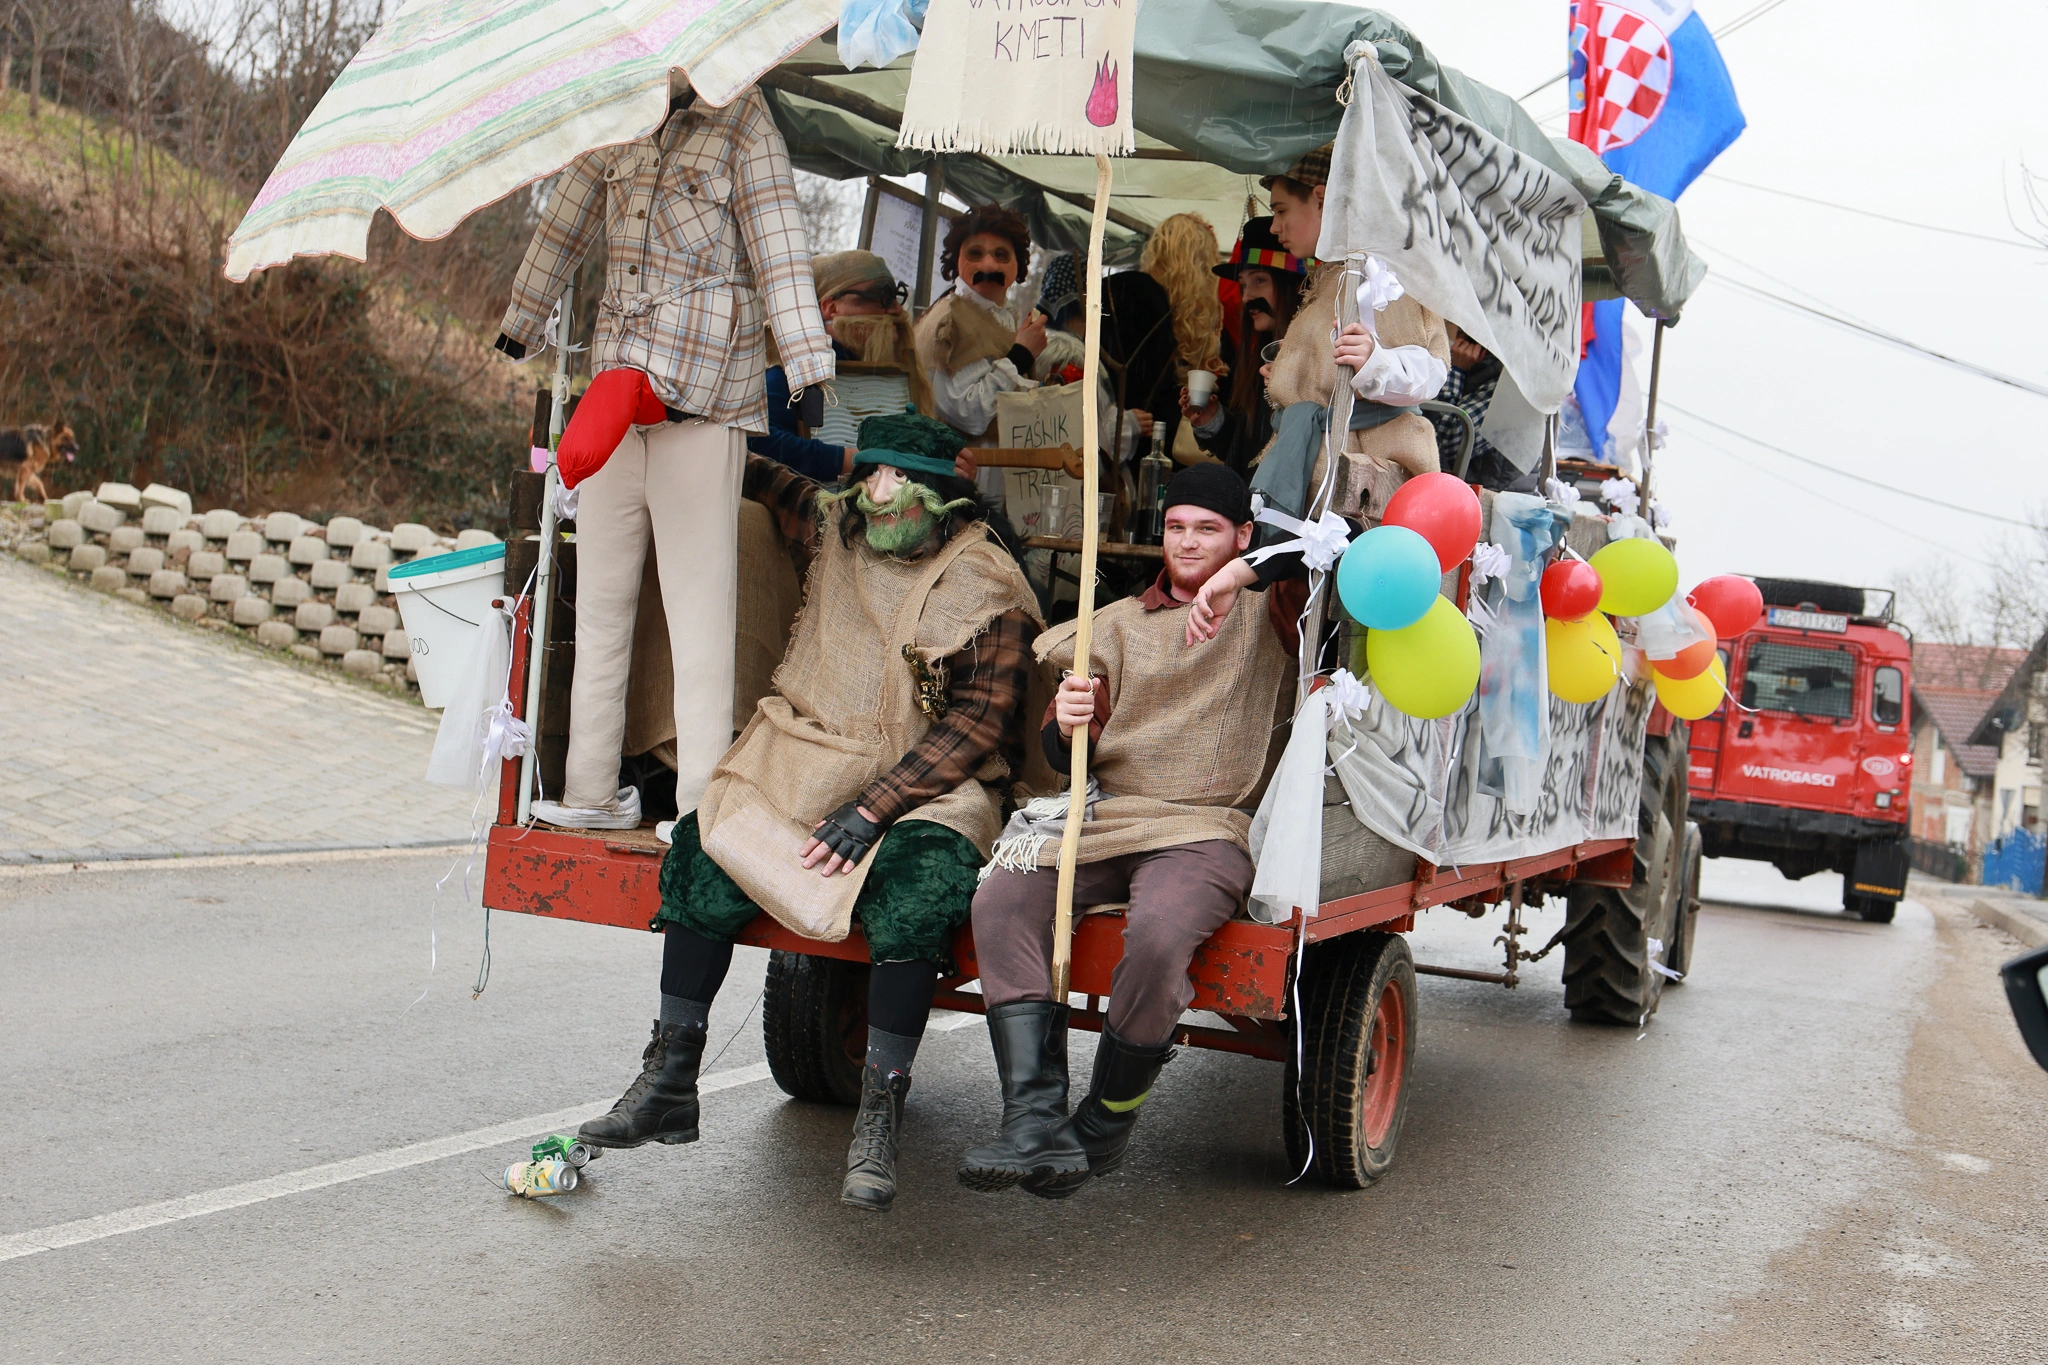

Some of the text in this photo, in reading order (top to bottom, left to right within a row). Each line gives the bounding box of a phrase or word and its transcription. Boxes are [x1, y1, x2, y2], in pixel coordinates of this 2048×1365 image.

[994, 16, 1085, 62] KMETI
[1011, 413, 1069, 449] FAŠNIK
[1742, 764, 1836, 787] VATROGASCI
